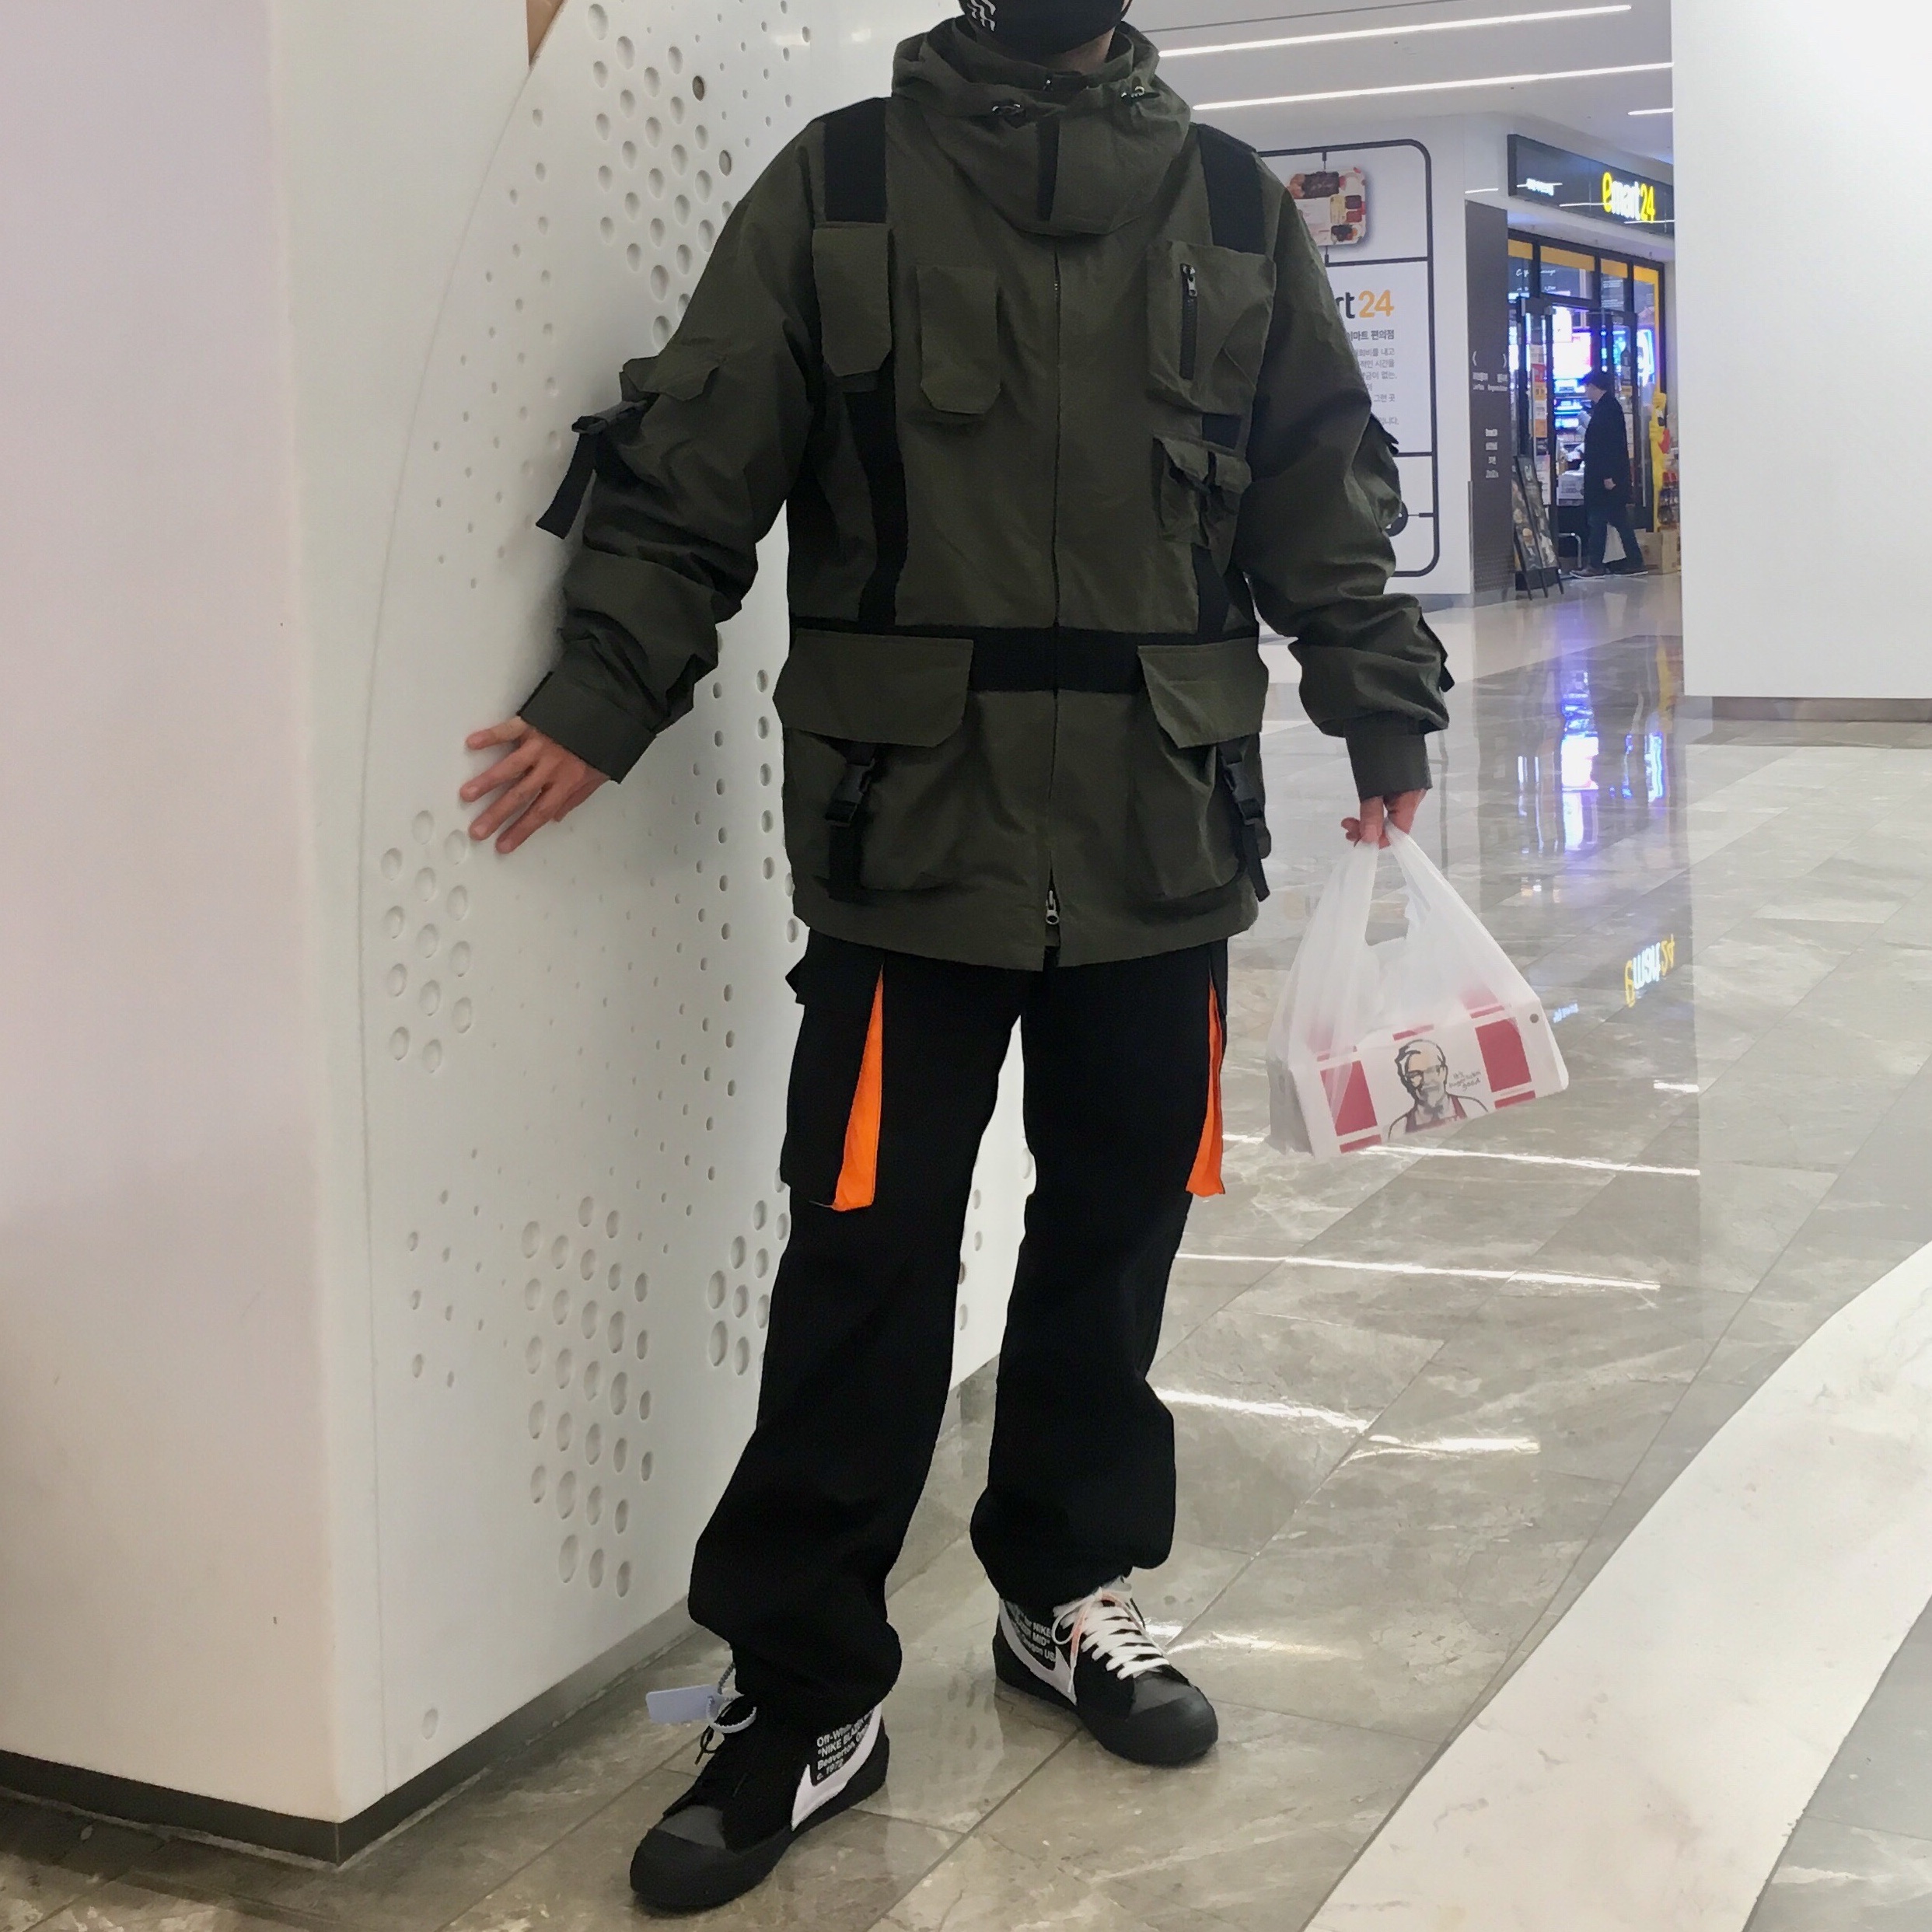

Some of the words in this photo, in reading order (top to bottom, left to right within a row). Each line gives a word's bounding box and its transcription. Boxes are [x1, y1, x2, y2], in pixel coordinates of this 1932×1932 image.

[1602, 172, 1655, 223] emart24
[1371, 330, 1395, 341] 편의점
[1381, 348, 1395, 356] 내고
[1375, 359, 1395, 368] 시간을
[1373, 393, 1387, 403] 그런
[1032, 1622, 1052, 1639] NIKE
[1044, 1648, 1057, 1662] US
